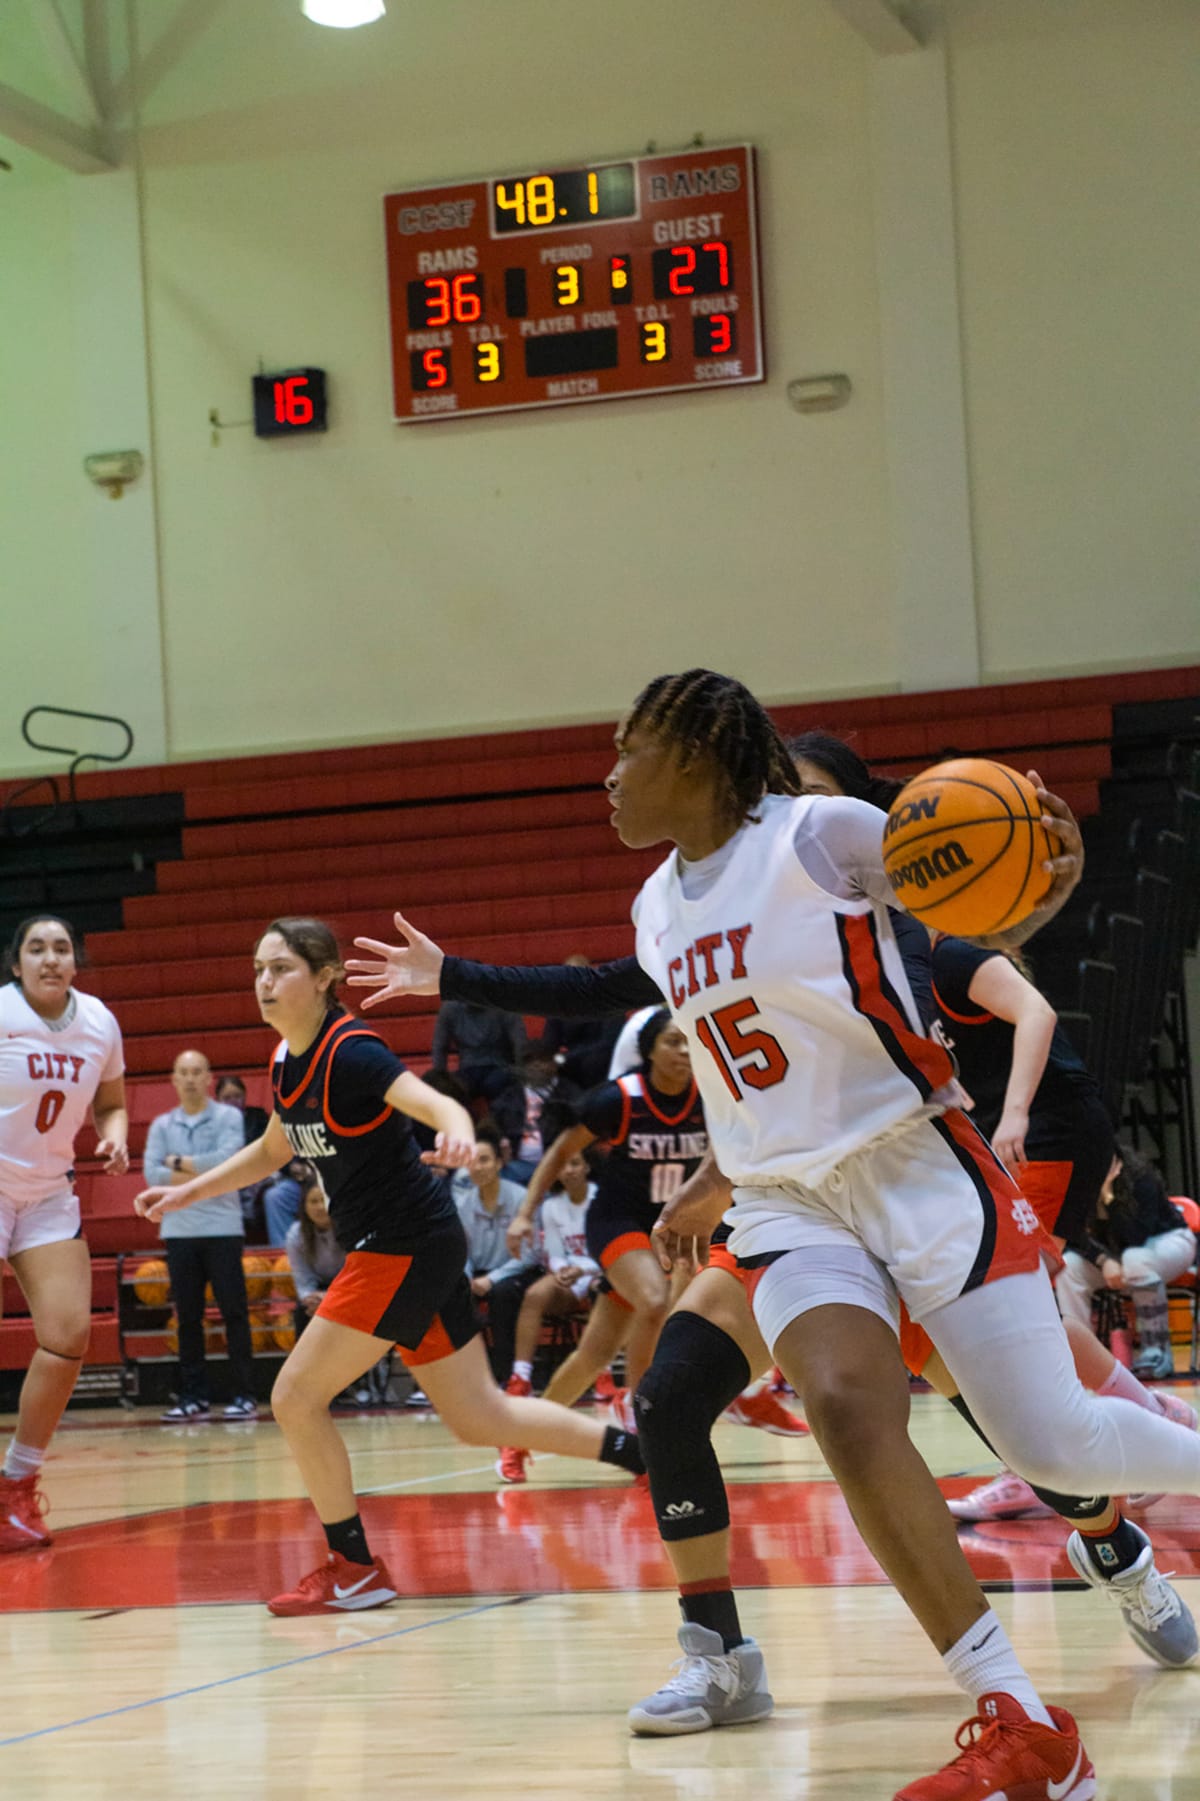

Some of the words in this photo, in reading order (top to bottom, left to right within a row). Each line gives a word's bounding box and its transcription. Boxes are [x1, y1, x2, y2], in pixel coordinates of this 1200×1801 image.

[649, 164, 740, 202] RAMS
[397, 199, 476, 236] CCSF
[653, 213, 724, 244] GUEST
[417, 246, 478, 275] RAMS
[540, 244, 592, 265] PERIOD
[669, 241, 729, 296] 27
[424, 274, 481, 327] 36
[556, 266, 579, 305] 3
[519, 314, 575, 337] PLAYER
[581, 310, 619, 330] FOUL
[690, 295, 738, 317] FOULS
[406, 330, 453, 350] FOULS
[643, 322, 666, 362] 3
[709, 313, 731, 353] 3
[423, 348, 447, 388] 5
[477, 342, 500, 381] 3
[694, 361, 742, 380] SCORE
[273, 375, 314, 426] 16
[412, 394, 457, 414] SCORE
[546, 377, 598, 398] MATCH
[667, 922, 753, 1010] CITY
[27, 1053, 85, 1084] CITY
[695, 996, 790, 1103] 15
[35, 1089, 66, 1135] 0
